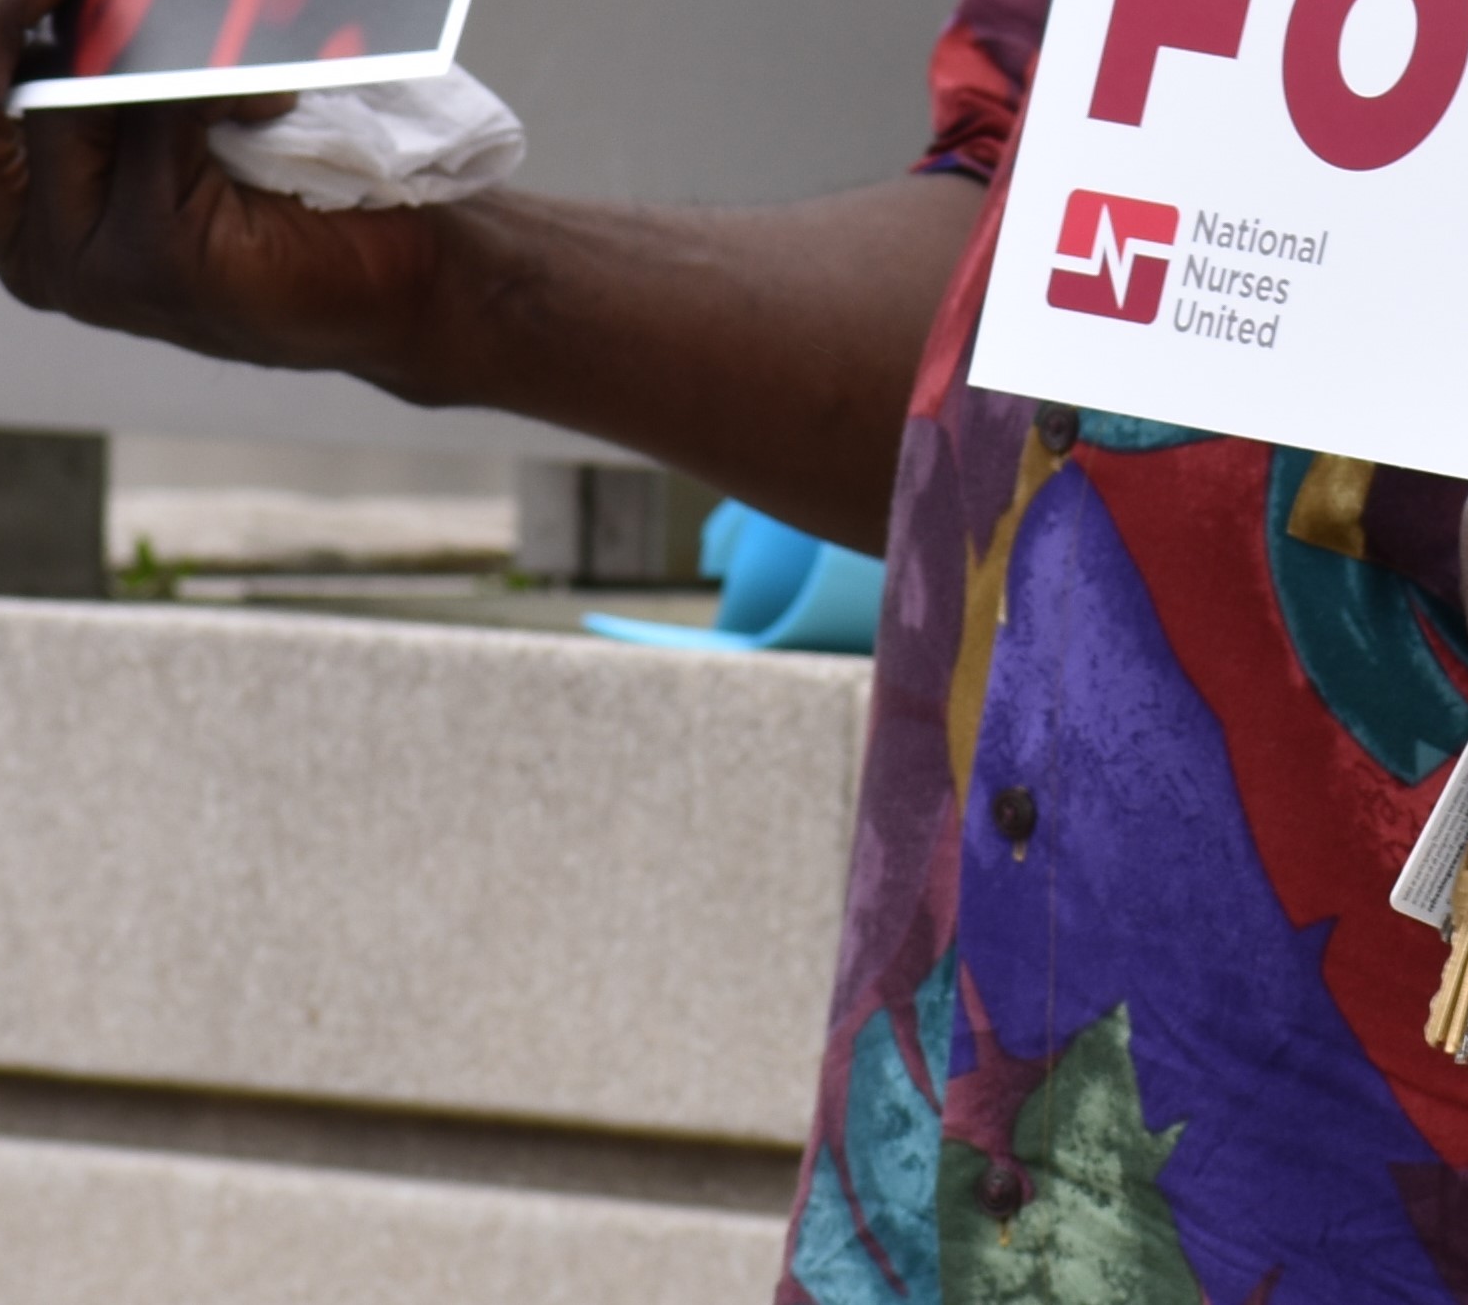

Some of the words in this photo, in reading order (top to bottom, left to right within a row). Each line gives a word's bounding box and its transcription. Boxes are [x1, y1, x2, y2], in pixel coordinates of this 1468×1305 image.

[1192, 209, 1329, 265] National
[1182, 254, 1290, 305] Nurses
[1173, 298, 1280, 349] United
